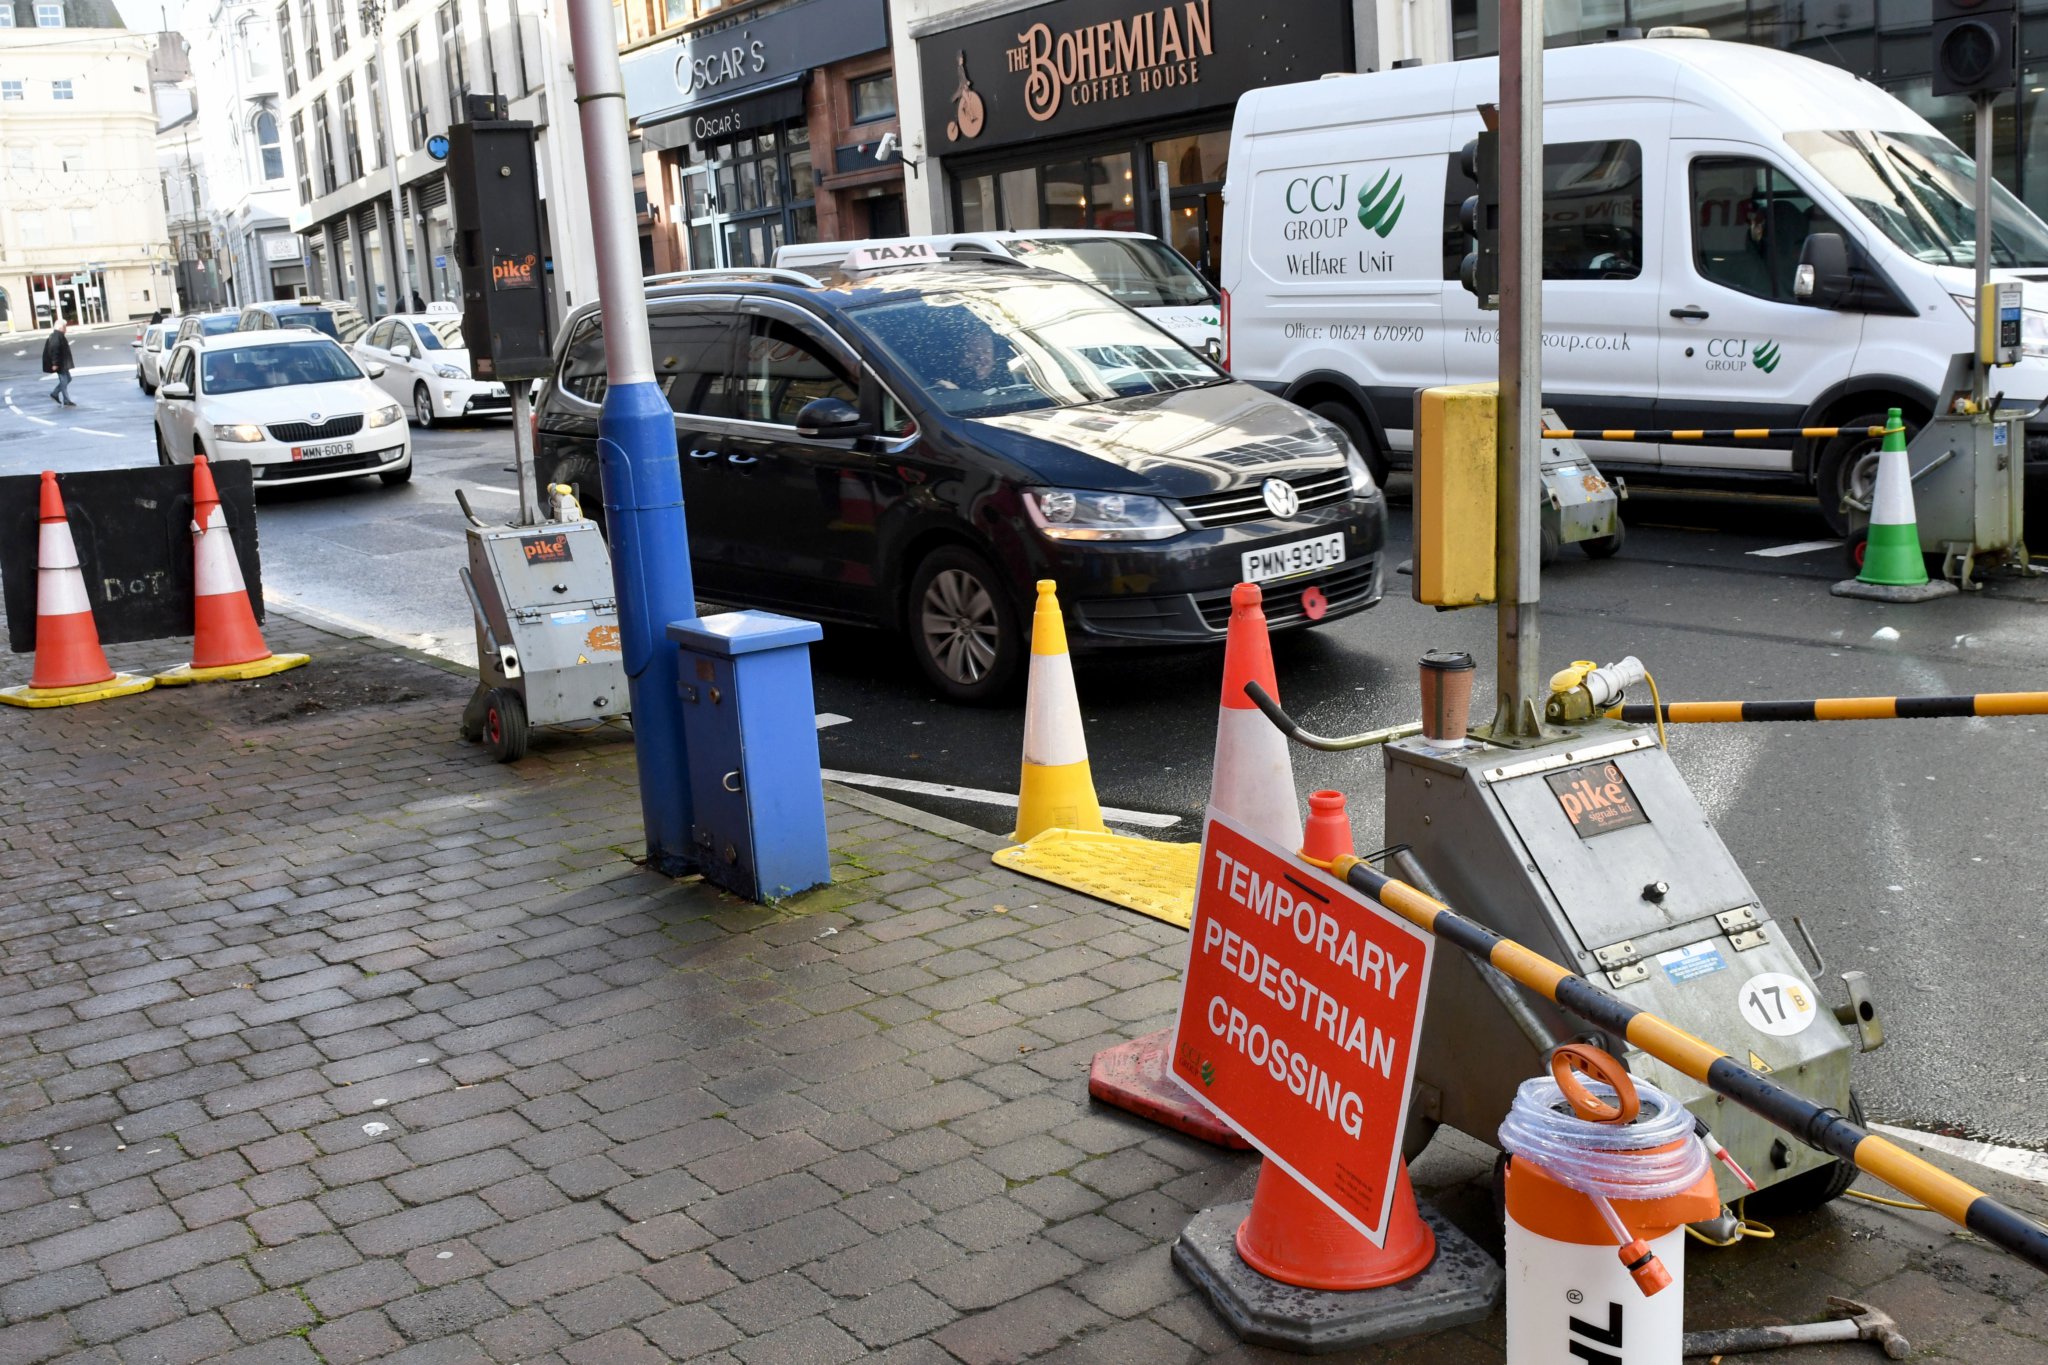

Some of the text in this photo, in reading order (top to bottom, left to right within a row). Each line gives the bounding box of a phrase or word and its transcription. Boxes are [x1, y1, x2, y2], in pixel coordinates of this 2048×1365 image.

[674, 31, 765, 95] OSCAR'S
[1006, 0, 1213, 121] THE BOHEMIAN
[1071, 61, 1199, 105] COFFEE HOUSE
[695, 108, 741, 138] OSCAR'S
[1285, 174, 1350, 214] CCJ
[1284, 217, 1348, 241] GROUP
[864, 244, 927, 261] TAXI
[493, 260, 531, 283] pike
[1284, 323, 1424, 342] Office: 01624 670950
[1707, 338, 1747, 358] CCJ
[1705, 360, 1747, 372] GROUP
[302, 443, 353, 459] MMN-600-R
[524, 540, 565, 560] pike
[1249, 538, 1340, 579] PMN-930-G
[1560, 780, 1627, 825] pike
[1588, 806, 1619, 823] signals
[1215, 849, 1410, 1001] TEMPORARY
[1203, 916, 1396, 1080] PEDESTRIAN
[1748, 985, 1787, 1025] 17
[1208, 995, 1364, 1141] CROSSING
